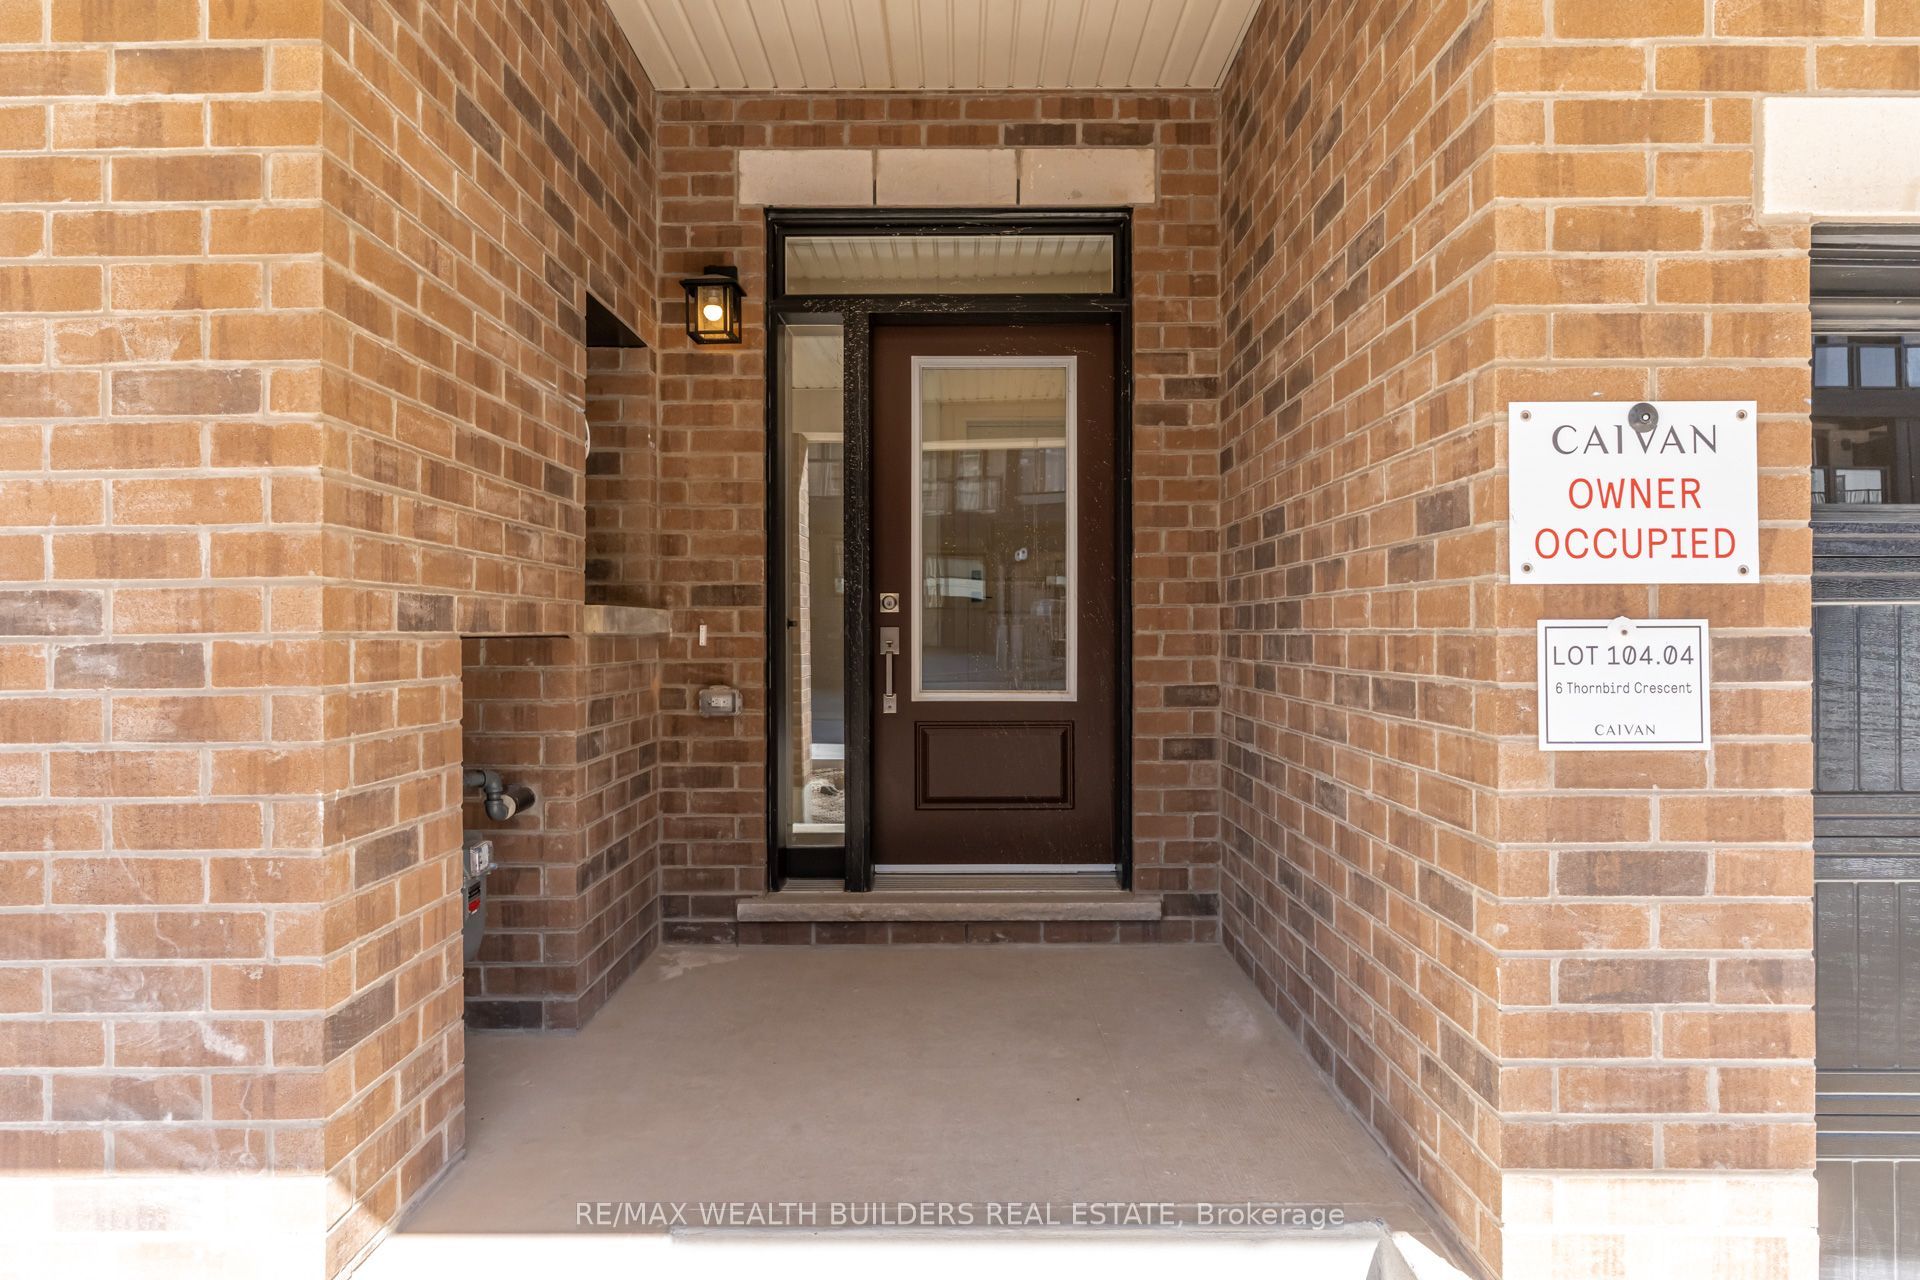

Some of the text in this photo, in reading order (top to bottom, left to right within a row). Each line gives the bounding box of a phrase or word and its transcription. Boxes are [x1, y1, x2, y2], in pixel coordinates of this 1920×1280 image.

[1552, 425, 1717, 455] CAIVAN
[1568, 477, 1702, 509] OWNER
[1534, 527, 1736, 559] OCCUPIED
[1553, 645, 1695, 665] LOT 104.04
[1555, 681, 1693, 695] 6 Thornbird Crescent
[1594, 724, 1656, 736] CAIVAN
